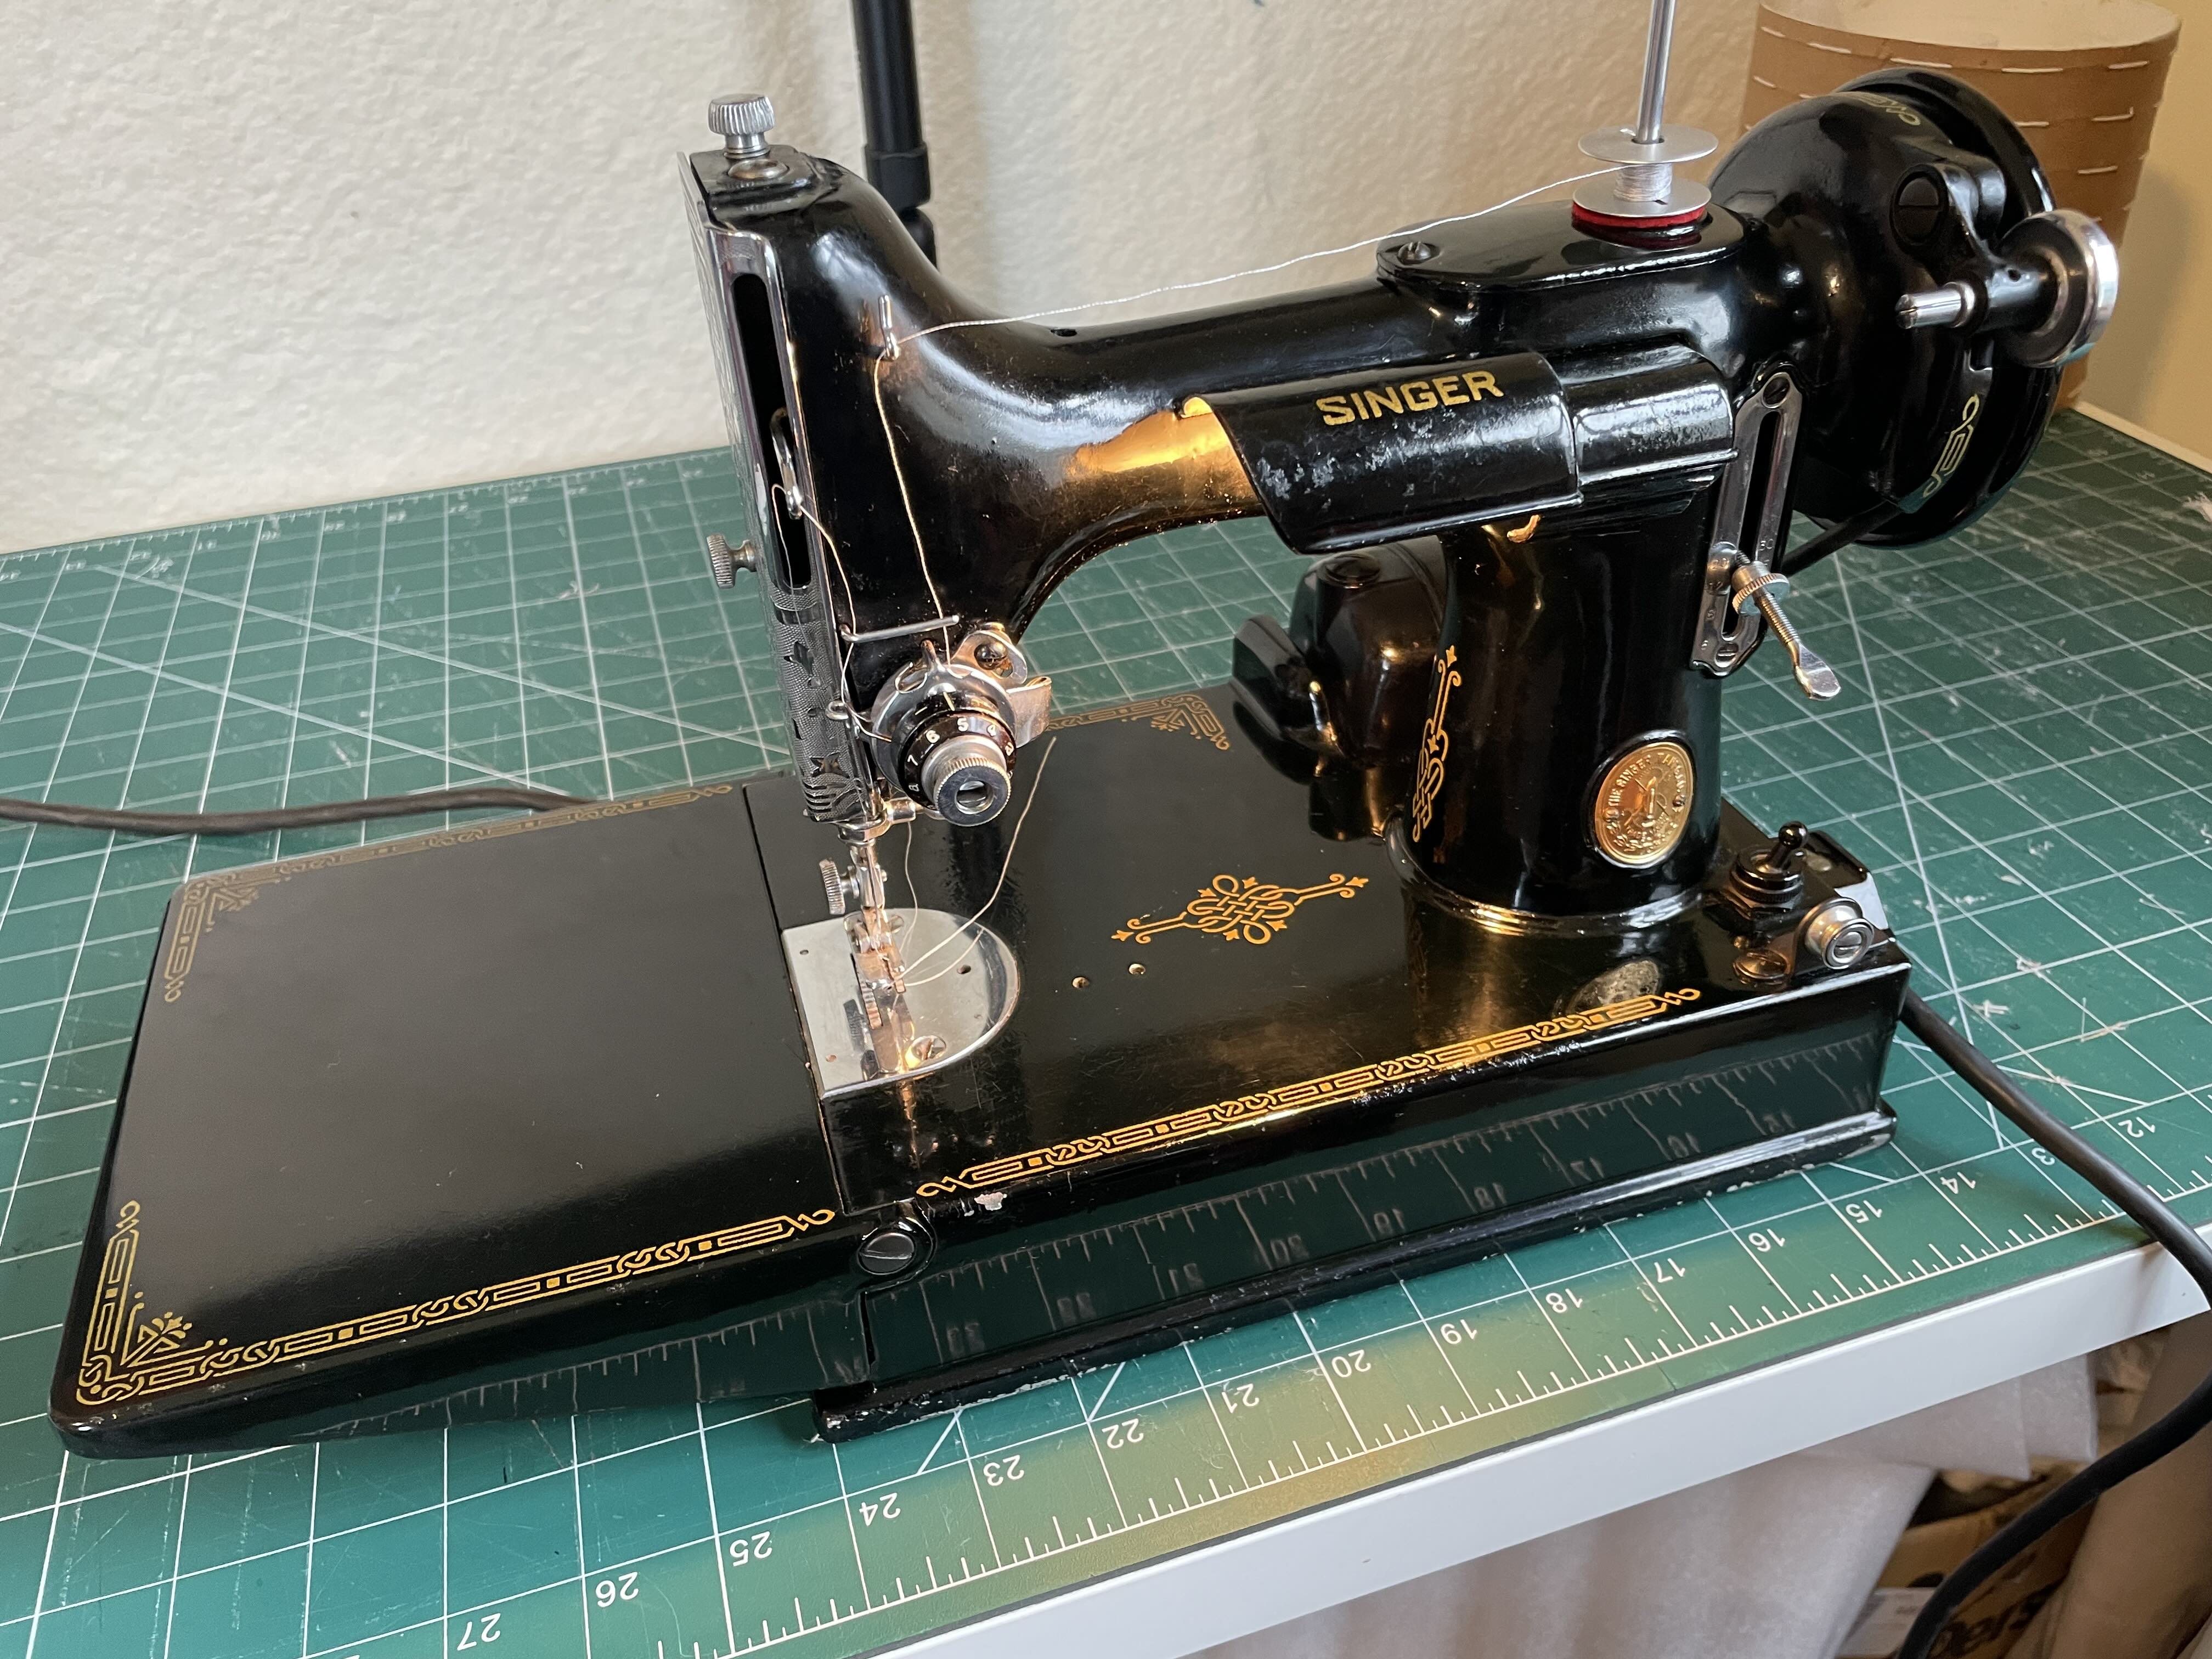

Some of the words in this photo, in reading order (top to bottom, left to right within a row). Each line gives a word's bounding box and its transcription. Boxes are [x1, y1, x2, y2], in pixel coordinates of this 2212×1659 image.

[1316, 370, 1504, 426] SINGER
[907, 754, 919, 766] 7
[926, 730, 940, 743] 6
[957, 718, 969, 732] 5
[987, 724, 997, 737] 4
[2118, 1117, 2156, 1137] 12
[2032, 1148, 2055, 1166] 3
[1940, 1172, 1976, 1194] 14
[1846, 1200, 1882, 1223] 15
[1748, 1229, 1785, 1253] 16
[1654, 1259, 1685, 1283] 17
[1545, 1288, 1583, 1313] 18
[1440, 1319, 1477, 1344] 19
[1331, 1350, 1371, 1378] 20
[1221, 1383, 1260, 1413] 21
[1102, 1418, 1144, 1449] 22
[984, 1454, 1024, 1486] 23
[859, 1492, 901, 1526] 24
[729, 1531, 772, 1566] 25
[595, 1571, 639, 1607] 26
[456, 1613, 501, 1651] 27
